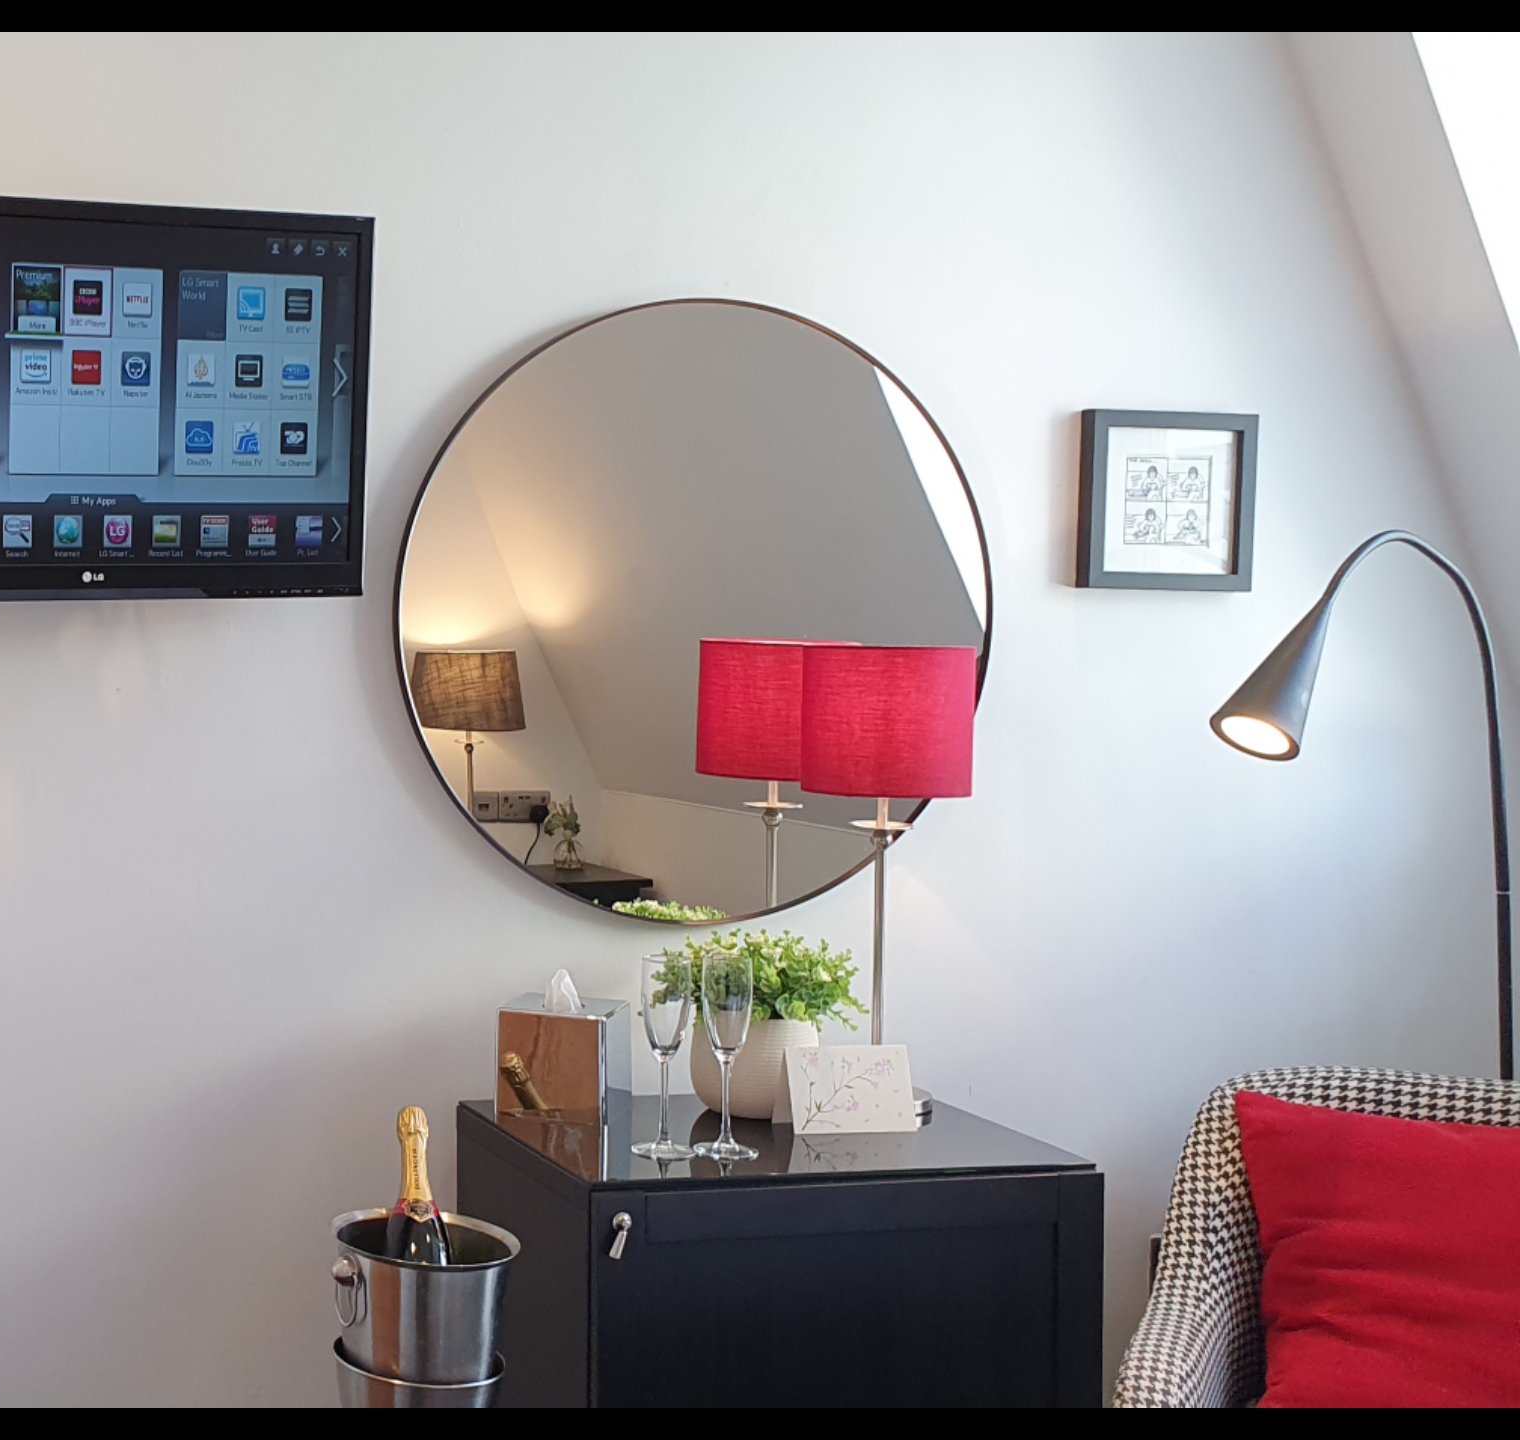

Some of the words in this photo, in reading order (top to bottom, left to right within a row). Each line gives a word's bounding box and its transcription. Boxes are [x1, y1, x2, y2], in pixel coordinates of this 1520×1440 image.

[16, 270, 53, 280] Premium
[182, 278, 193, 287] LG
[195, 278, 219, 288] Smart
[182, 290, 206, 300] World
[29, 321, 46, 330] More
[25, 352, 47, 362] prime
[25, 363, 47, 371] video
[82, 497, 94, 507] My
[96, 497, 116, 507] Apps
[109, 526, 126, 536] LG
[251, 525, 274, 533] Guide
[93, 573, 105, 581] LG
